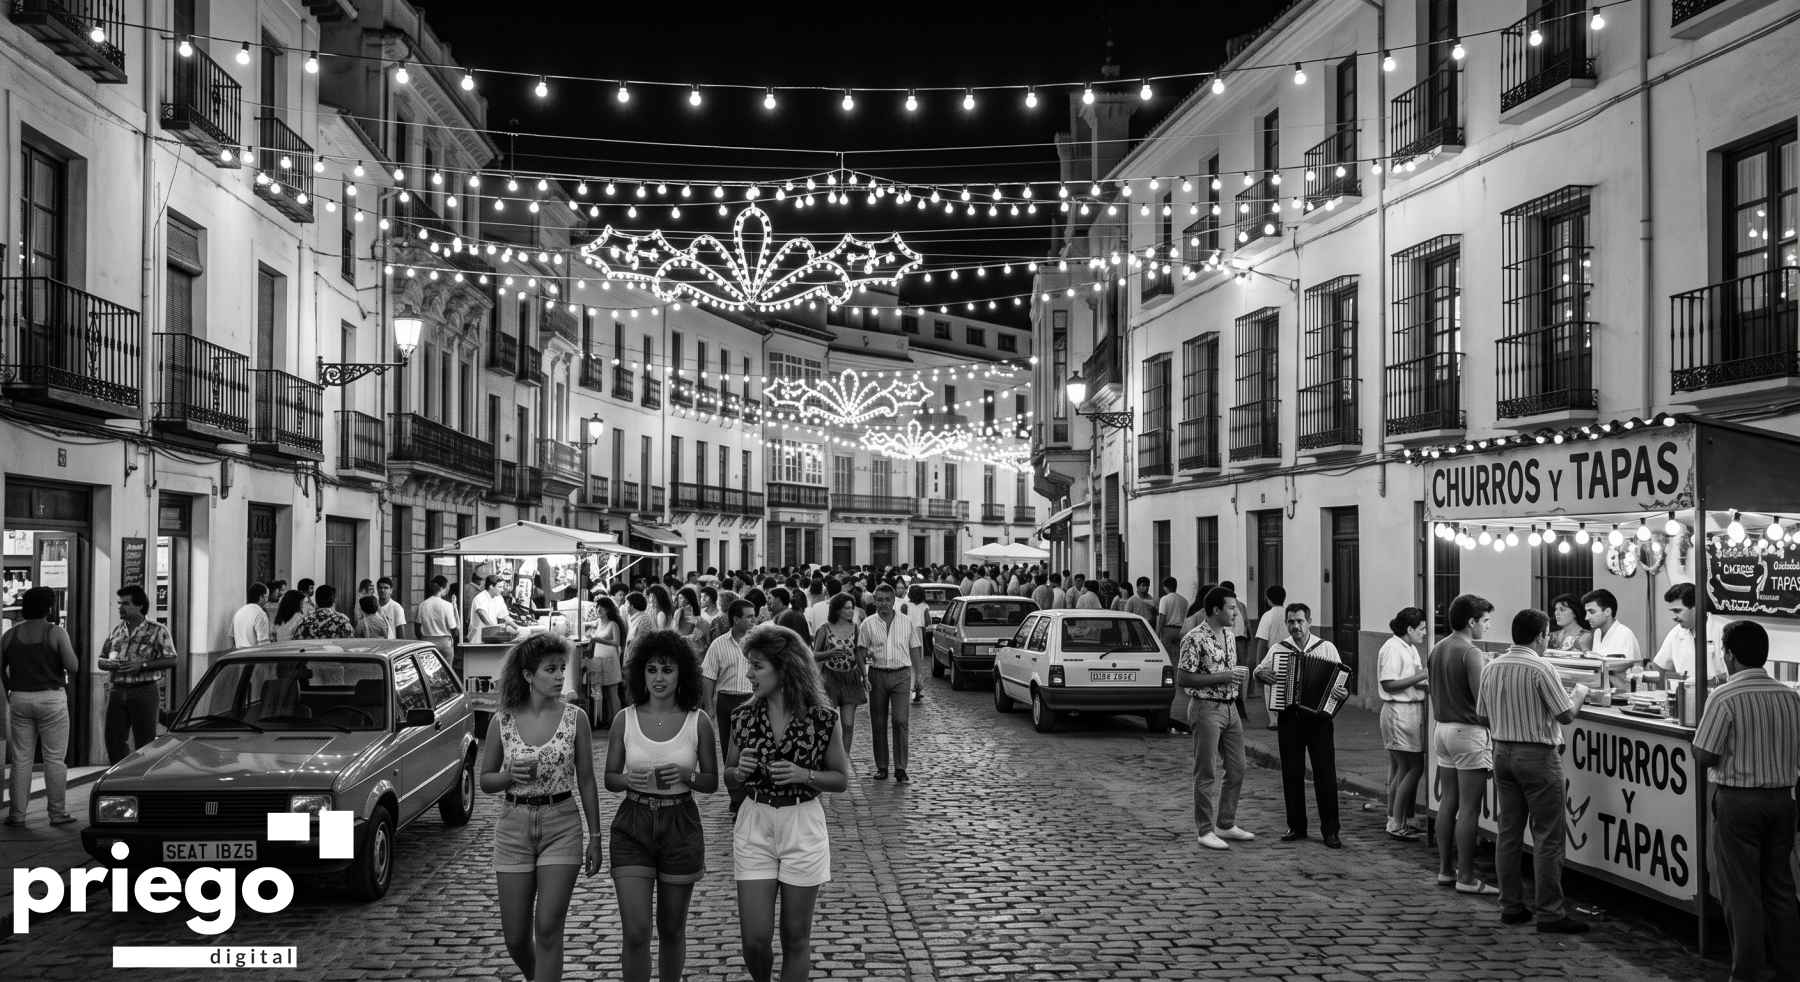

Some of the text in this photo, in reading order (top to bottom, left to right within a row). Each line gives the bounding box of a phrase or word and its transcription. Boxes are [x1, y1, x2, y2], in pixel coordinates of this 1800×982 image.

[1432, 441, 1679, 508] CHURROS Y TAPAS
[1572, 728, 1688, 795] CHURROS
[1621, 788, 1636, 814] Y
[166, 844, 208, 860] SEAT
[1597, 812, 1689, 887] TAPAS
